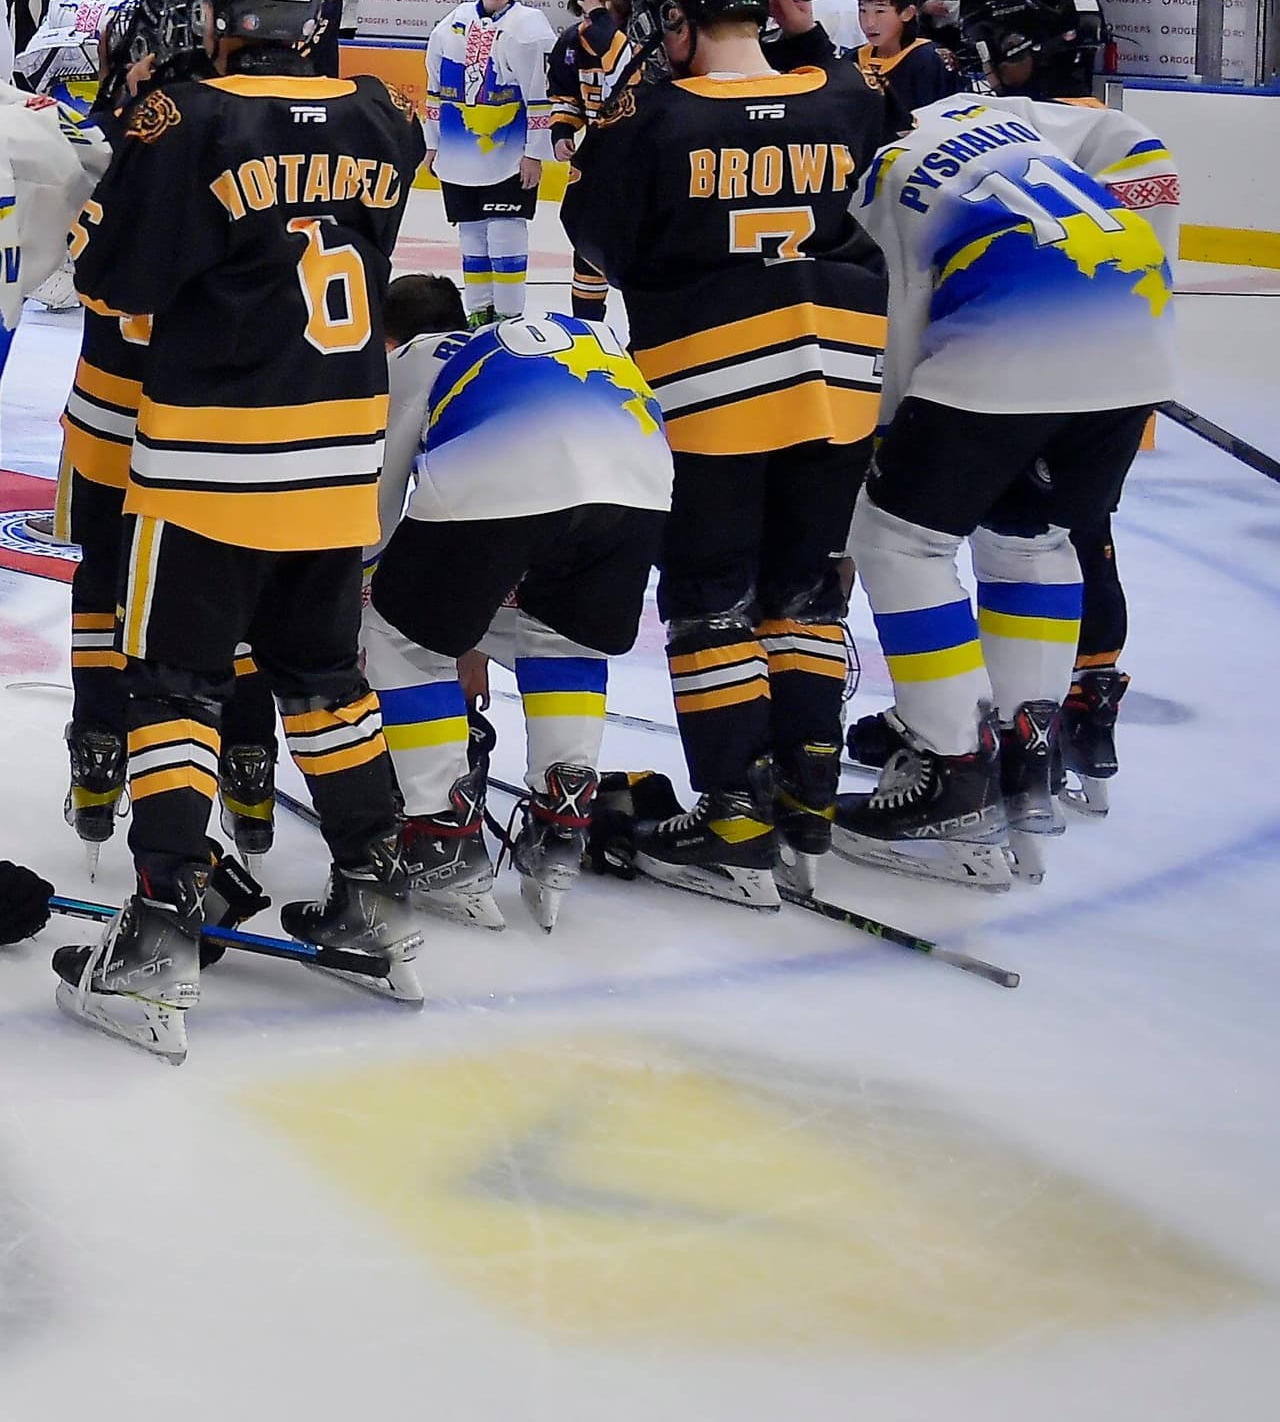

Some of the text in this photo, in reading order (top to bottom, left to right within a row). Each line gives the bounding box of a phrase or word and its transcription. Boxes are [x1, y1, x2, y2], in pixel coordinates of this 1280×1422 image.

[1171, 26, 1197, 35] ROGE
[1118, 54, 1149, 62] OGERS
[1170, 56, 1196, 65] ROGE
[290, 106, 327, 123] TPS
[745, 104, 786, 120] TPS
[899, 121, 1041, 215] PYSHALKO
[482, 203, 522, 212] CCM
[959, 157, 1126, 247] 11
[729, 205, 817, 267] 7
[287, 215, 372, 356] 6
